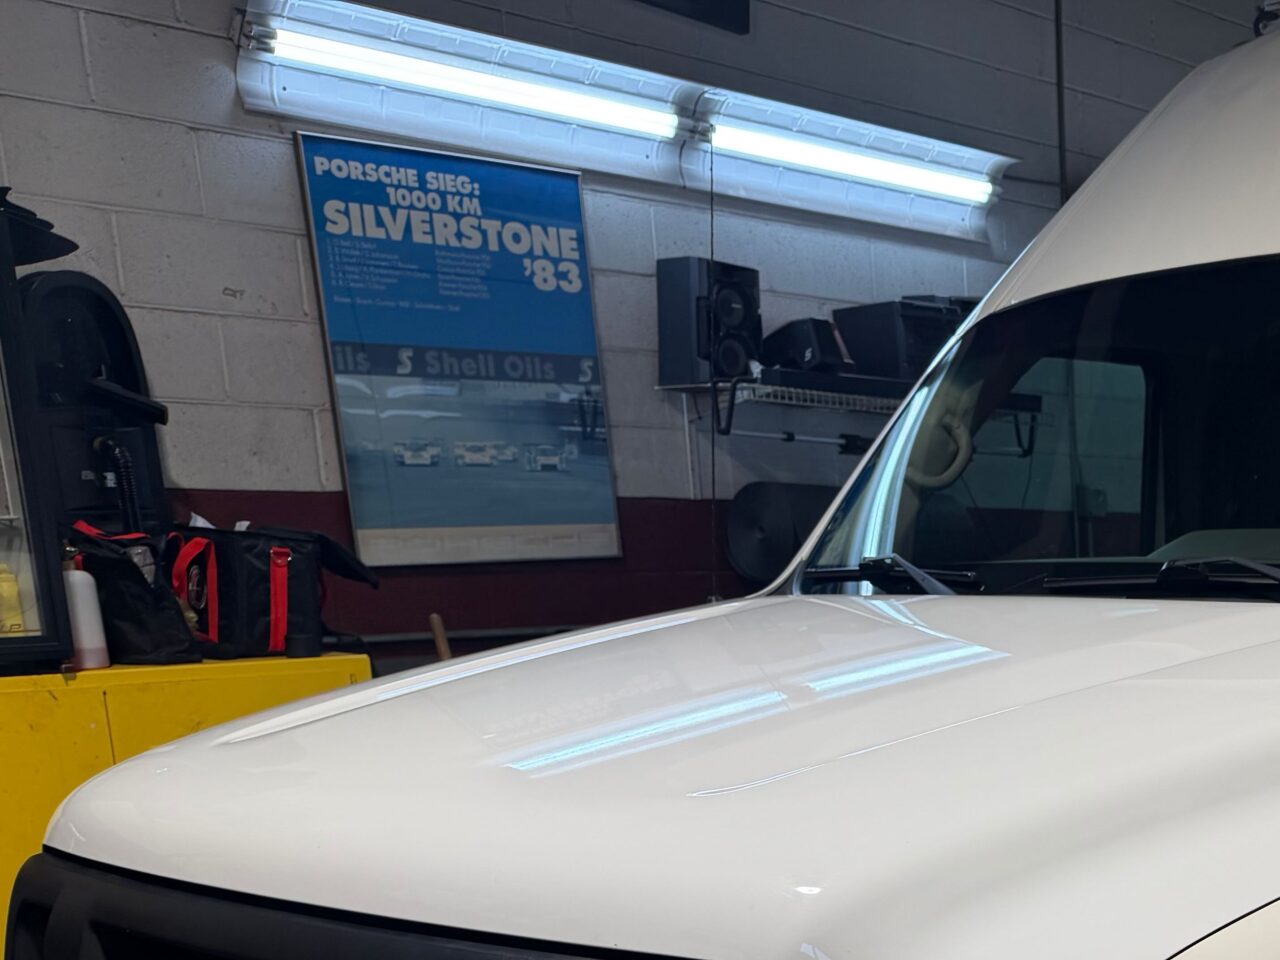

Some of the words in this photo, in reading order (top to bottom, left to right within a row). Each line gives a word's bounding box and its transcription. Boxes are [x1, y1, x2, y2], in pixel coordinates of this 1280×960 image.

[314, 156, 419, 187] PORSCHE
[425, 170, 480, 195] SIEG:
[386, 186, 441, 210] 1000
[447, 194, 482, 216] KM
[323, 200, 580, 260] SILVERSTONE
[523, 259, 582, 293] '83
[425, 350, 496, 378] Shell
[503, 354, 556, 380] Oils
